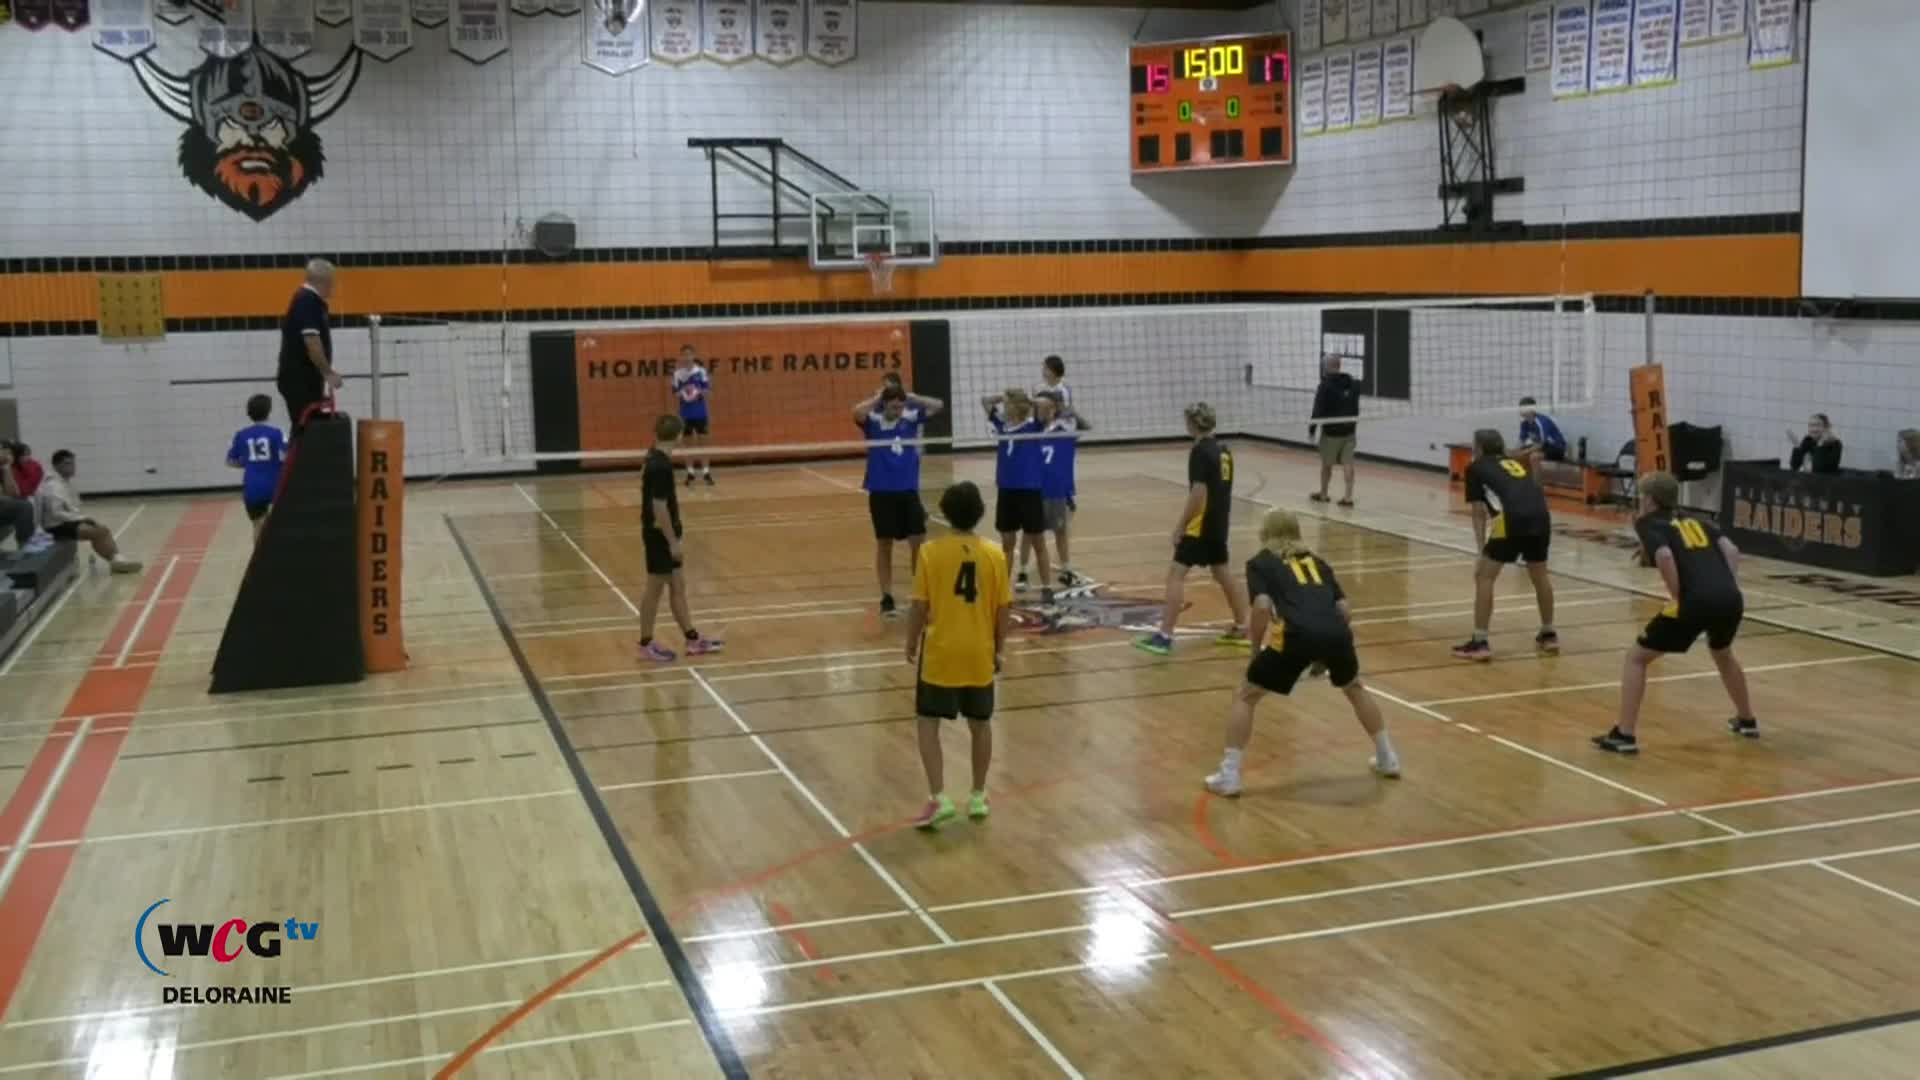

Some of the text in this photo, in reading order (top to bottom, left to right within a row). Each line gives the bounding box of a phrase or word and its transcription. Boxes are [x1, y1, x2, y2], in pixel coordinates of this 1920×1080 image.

[1264, 53, 1289, 82] 17
[1179, 100, 1191, 122] 0
[1227, 96, 1240, 118] 0
[588, 356, 675, 379] HOME
[730, 354, 773, 374] THE
[783, 350, 903, 372] RAIDERS
[1647, 391, 1666, 471] RAID
[246, 437, 270, 462] 13
[1041, 445, 1055, 464] 7
[1670, 518, 1711, 549] 10
[1733, 499, 1863, 549] RAIDERS
[370, 450, 390, 636] RAIDERS
[954, 561, 977, 603] 4
[1288, 557, 1324, 585] 11
